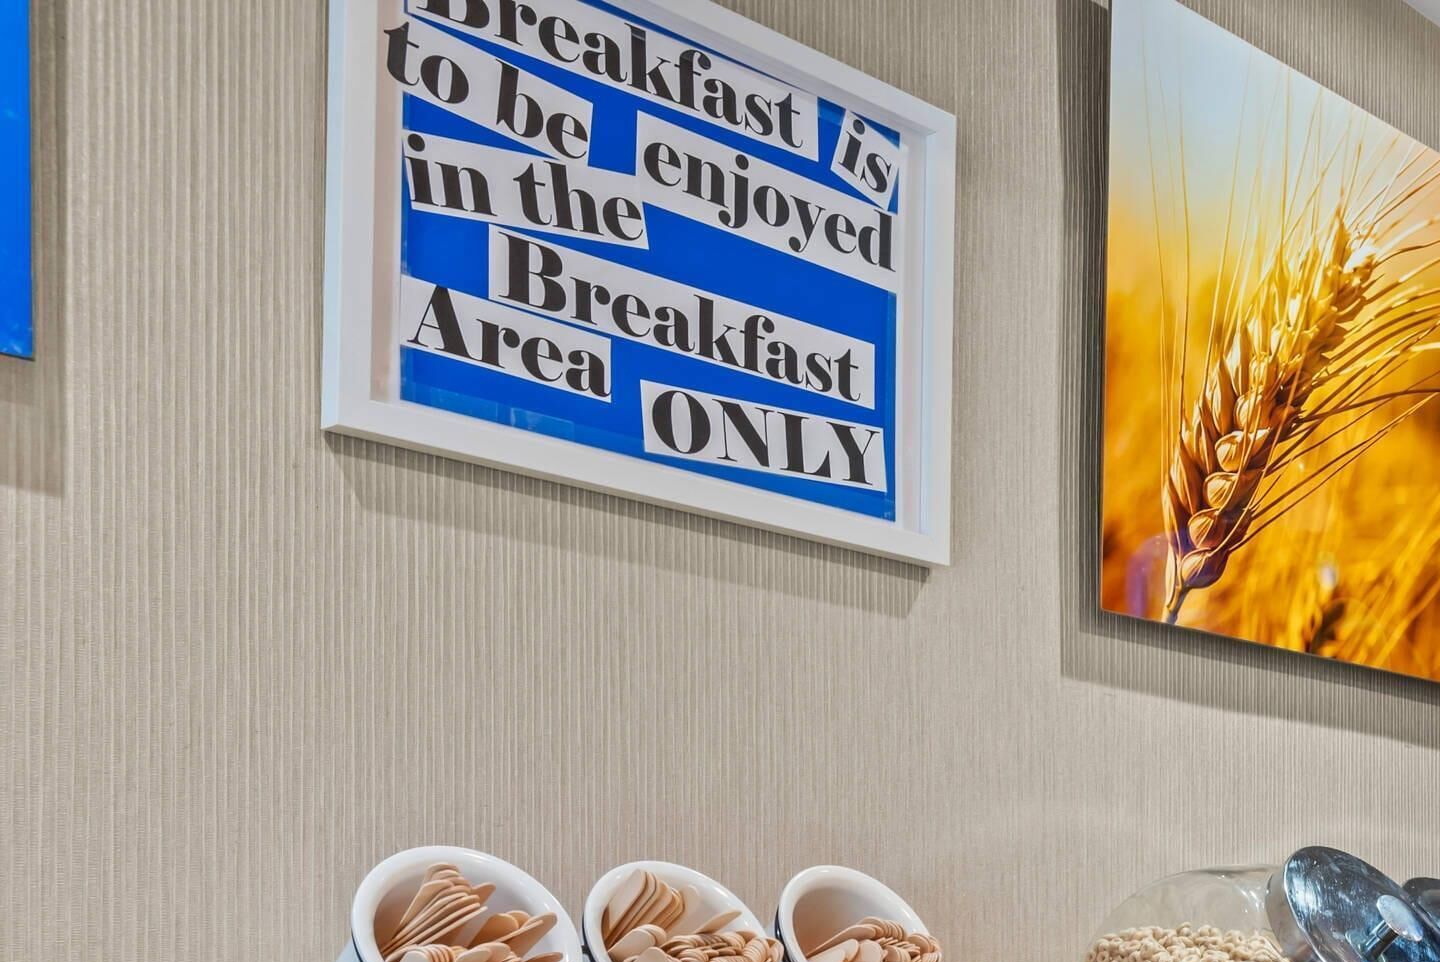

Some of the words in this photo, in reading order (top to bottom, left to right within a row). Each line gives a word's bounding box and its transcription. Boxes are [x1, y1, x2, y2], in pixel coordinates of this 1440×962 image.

[384, 22, 470, 105] to
[496, 58, 588, 159] be
[644, 140, 896, 273] enjoyed
[404, 133, 498, 217] in
[513, 161, 644, 241] the
[839, 117, 892, 195] is
[407, 285, 612, 398] Area
[652, 388, 881, 486] ONLY
[498, 231, 862, 402] Breakfast
